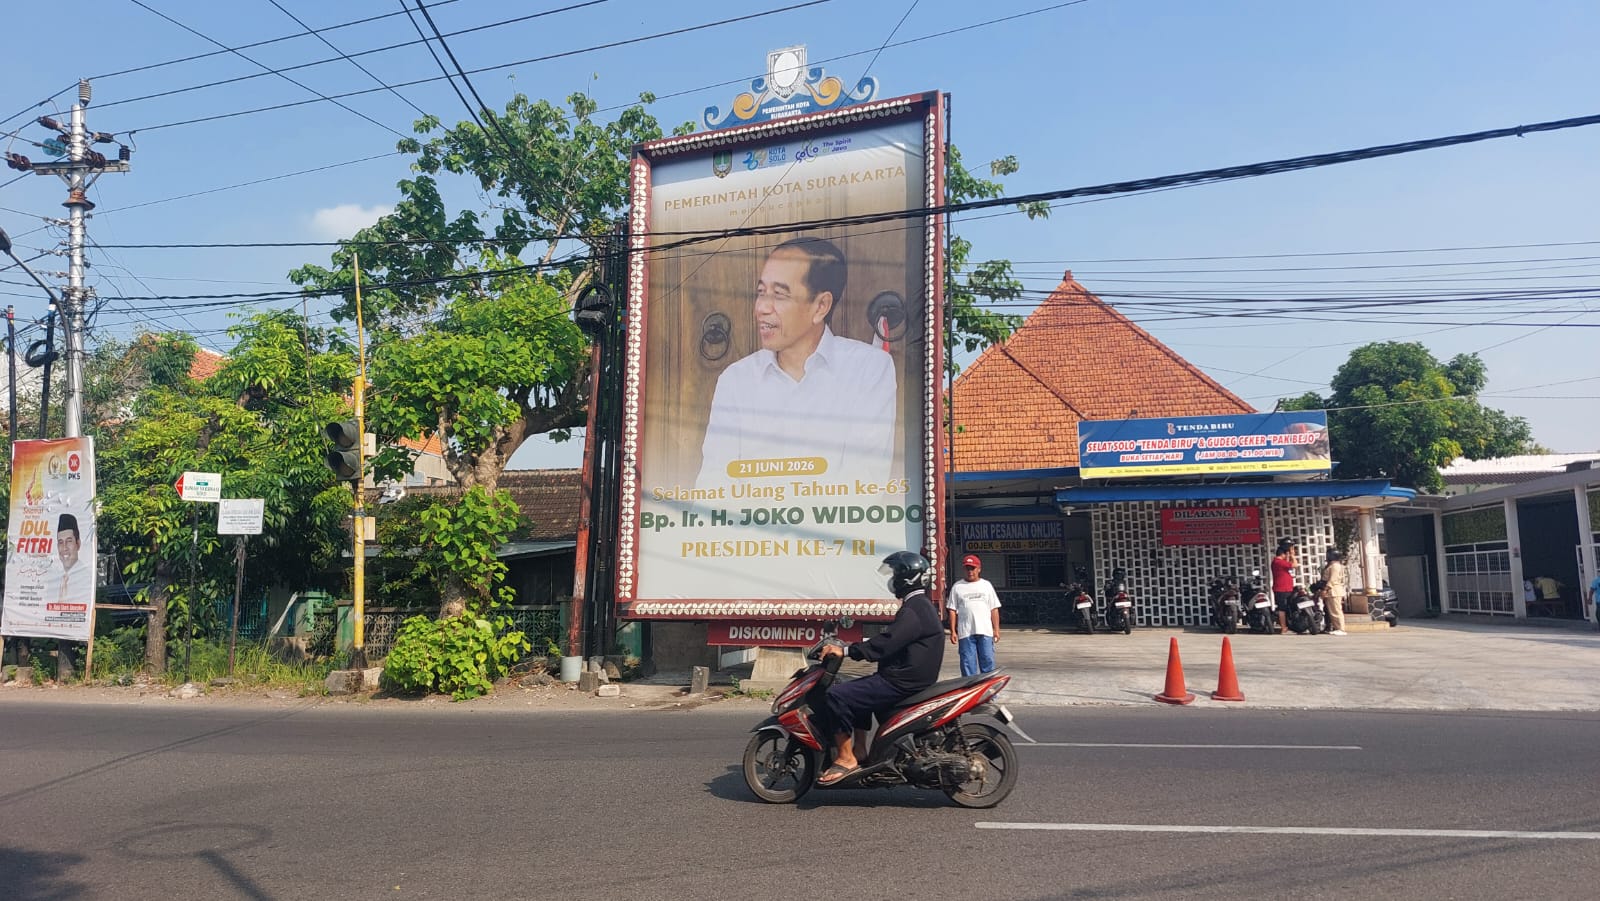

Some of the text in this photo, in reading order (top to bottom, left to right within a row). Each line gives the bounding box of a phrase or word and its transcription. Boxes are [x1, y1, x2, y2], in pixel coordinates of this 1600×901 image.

[762, 103, 795, 114] PEMERINTAH
[835, 138, 852, 146] Spirit
[664, 165, 905, 211] PEMERINTAH KOTA SURAKARTA
[1176, 423, 1209, 432] TENDA
[1210, 422, 1235, 430] BIRU
[1087, 441, 1112, 452] SELAT
[1112, 440, 1135, 451] SOLO
[1199, 436, 1206, 447] &
[1207, 435, 1238, 447] GUDEG
[1239, 434, 1267, 446] CEKER
[1121, 452, 1183, 462] BUKA SETIAP HARI
[739, 461, 815, 474] 21 JUNI 2026
[653, 478, 911, 502] Selamat Ulang Tahun ke-65
[640, 504, 923, 532] Bp. Ir. H. JOKO WIDODO
[1174, 509, 1232, 519] DILARANG
[20, 520, 51, 536] IDUL
[964, 521, 1062, 540] KASIR PESANAN ONLINE
[17, 537, 53, 554] FITRI
[681, 539, 876, 558] PRESIDEN KE-7 RI
[968, 541, 994, 550] GOJEK
[1000, 541, 1022, 550] GRAB
[729, 626, 816, 641] DISKOMINFO
